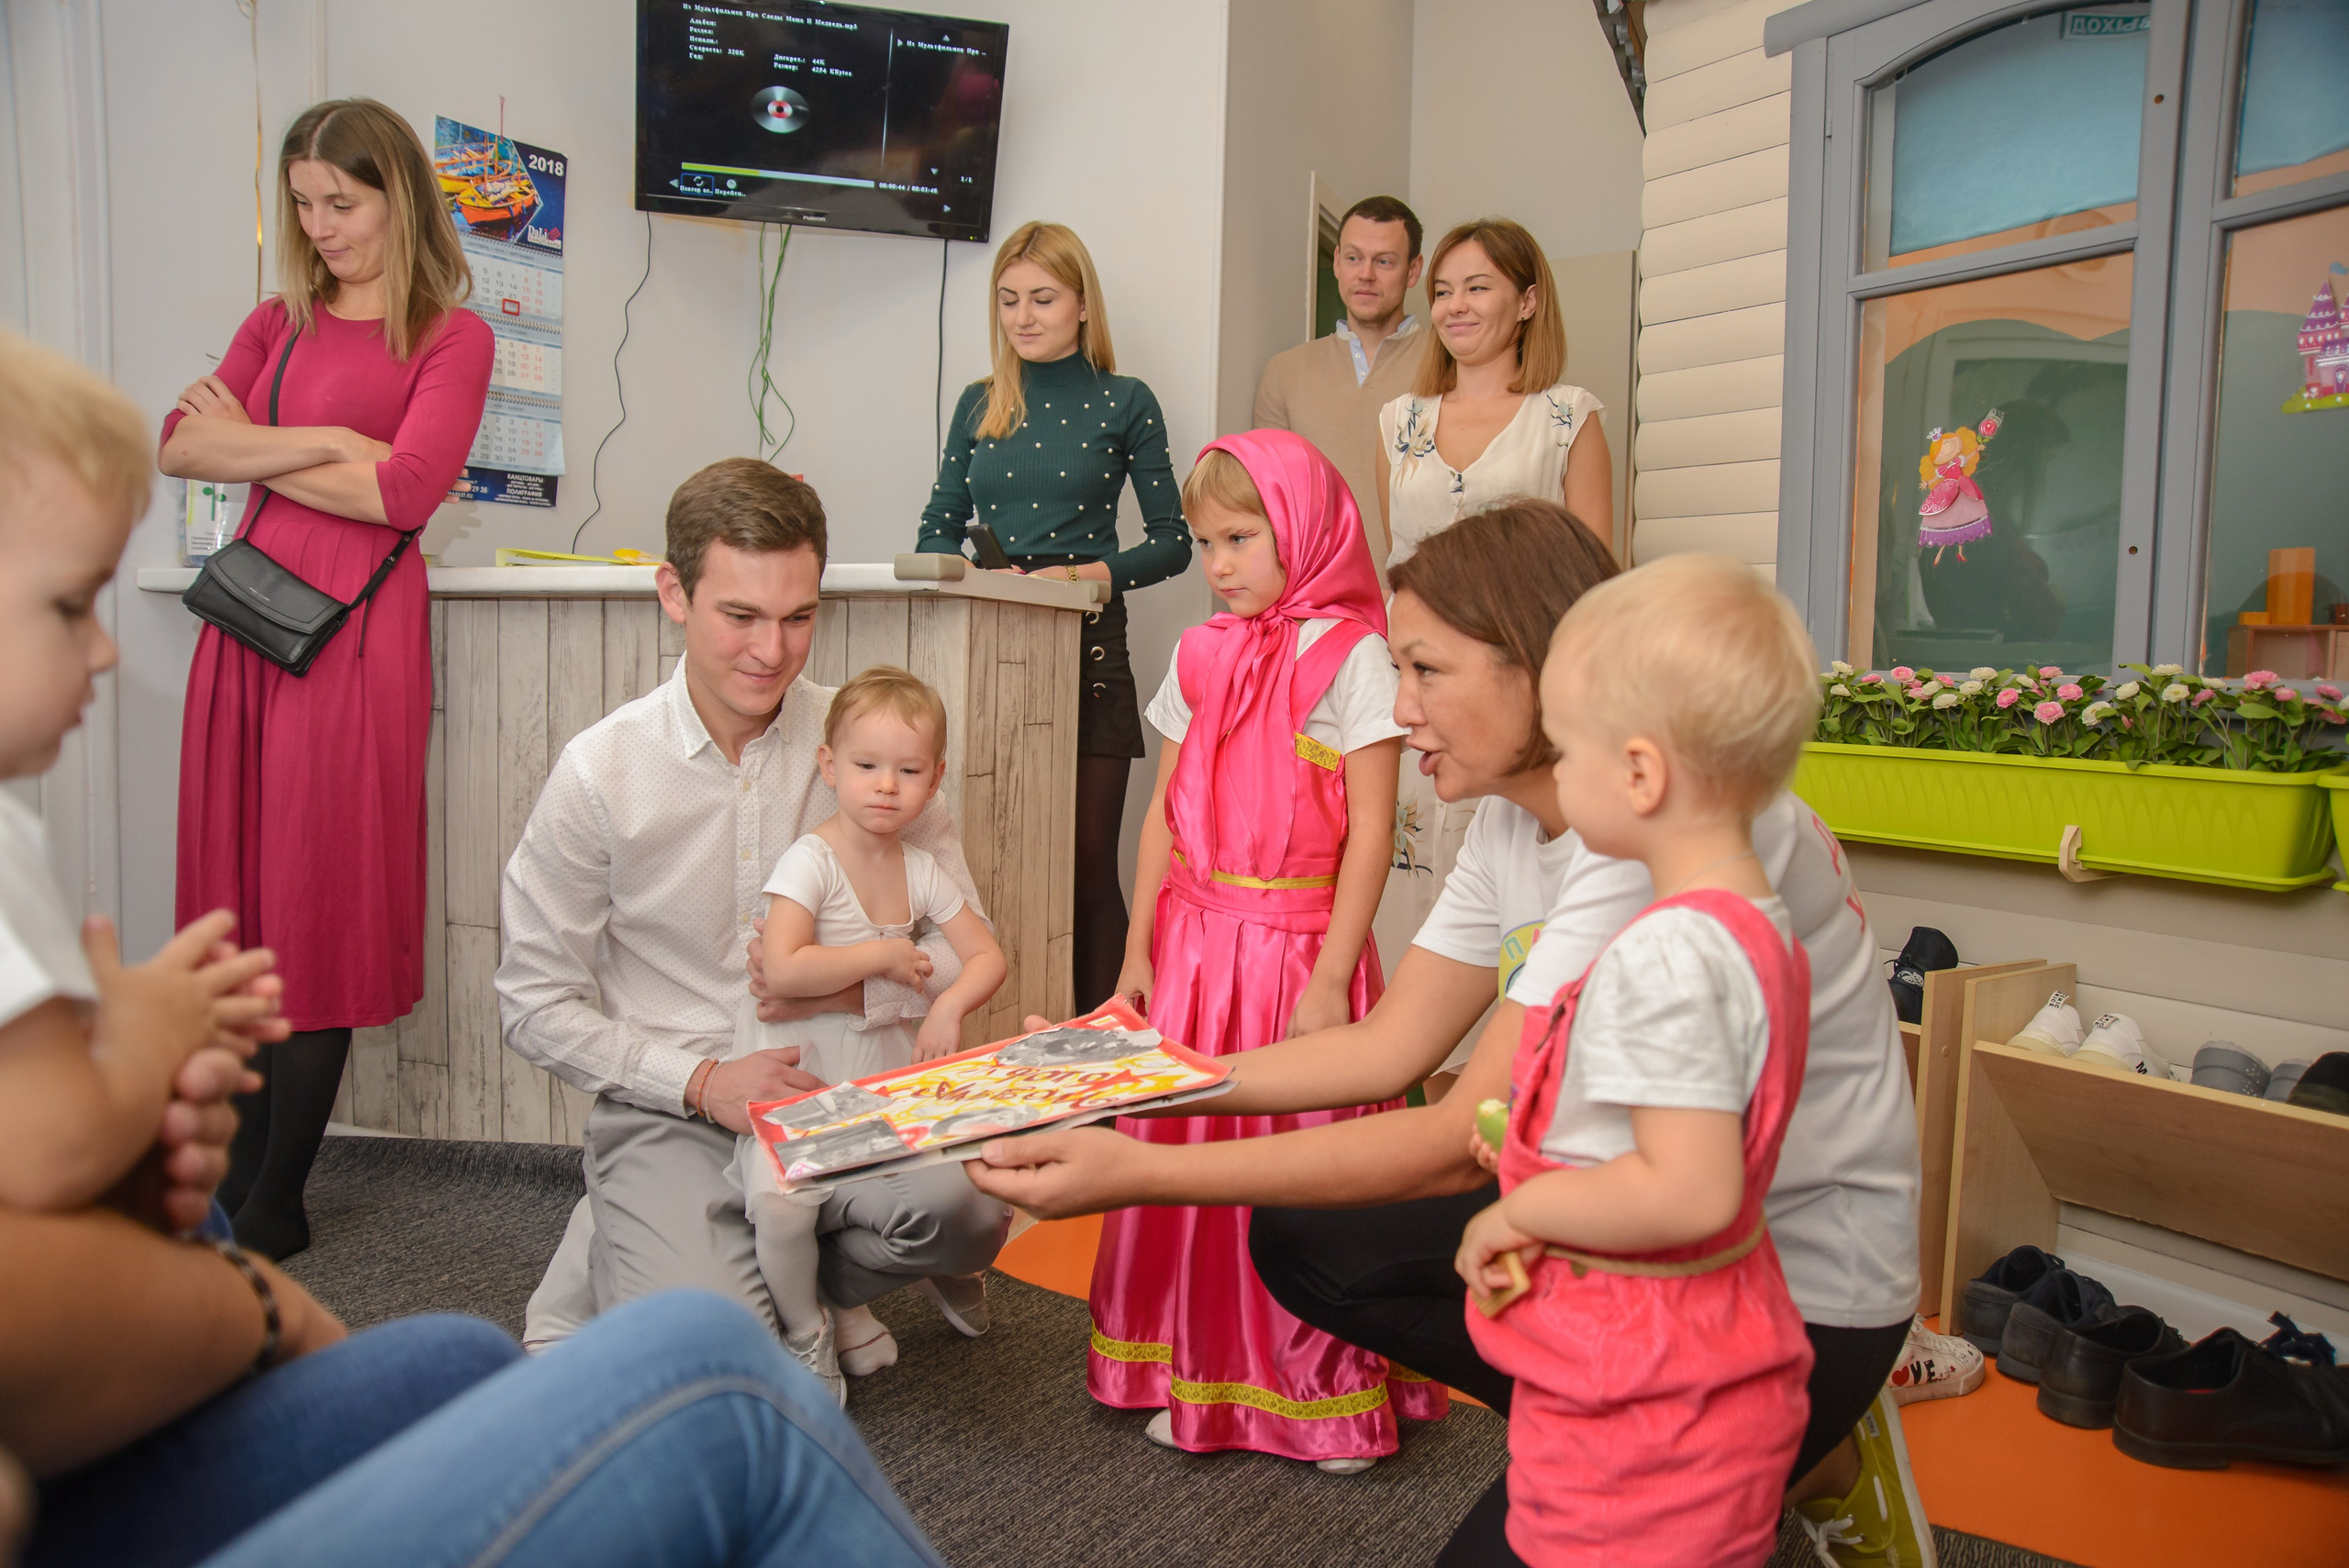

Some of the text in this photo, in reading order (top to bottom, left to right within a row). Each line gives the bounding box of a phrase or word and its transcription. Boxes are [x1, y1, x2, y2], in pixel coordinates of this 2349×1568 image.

[967, 48, 979, 56] Про
[528, 154, 564, 177] 2018
[507, 473, 544, 483] КАНЦТОВАРЫ
[506, 488, 542, 497] ПОЛИГРАФИЯ
